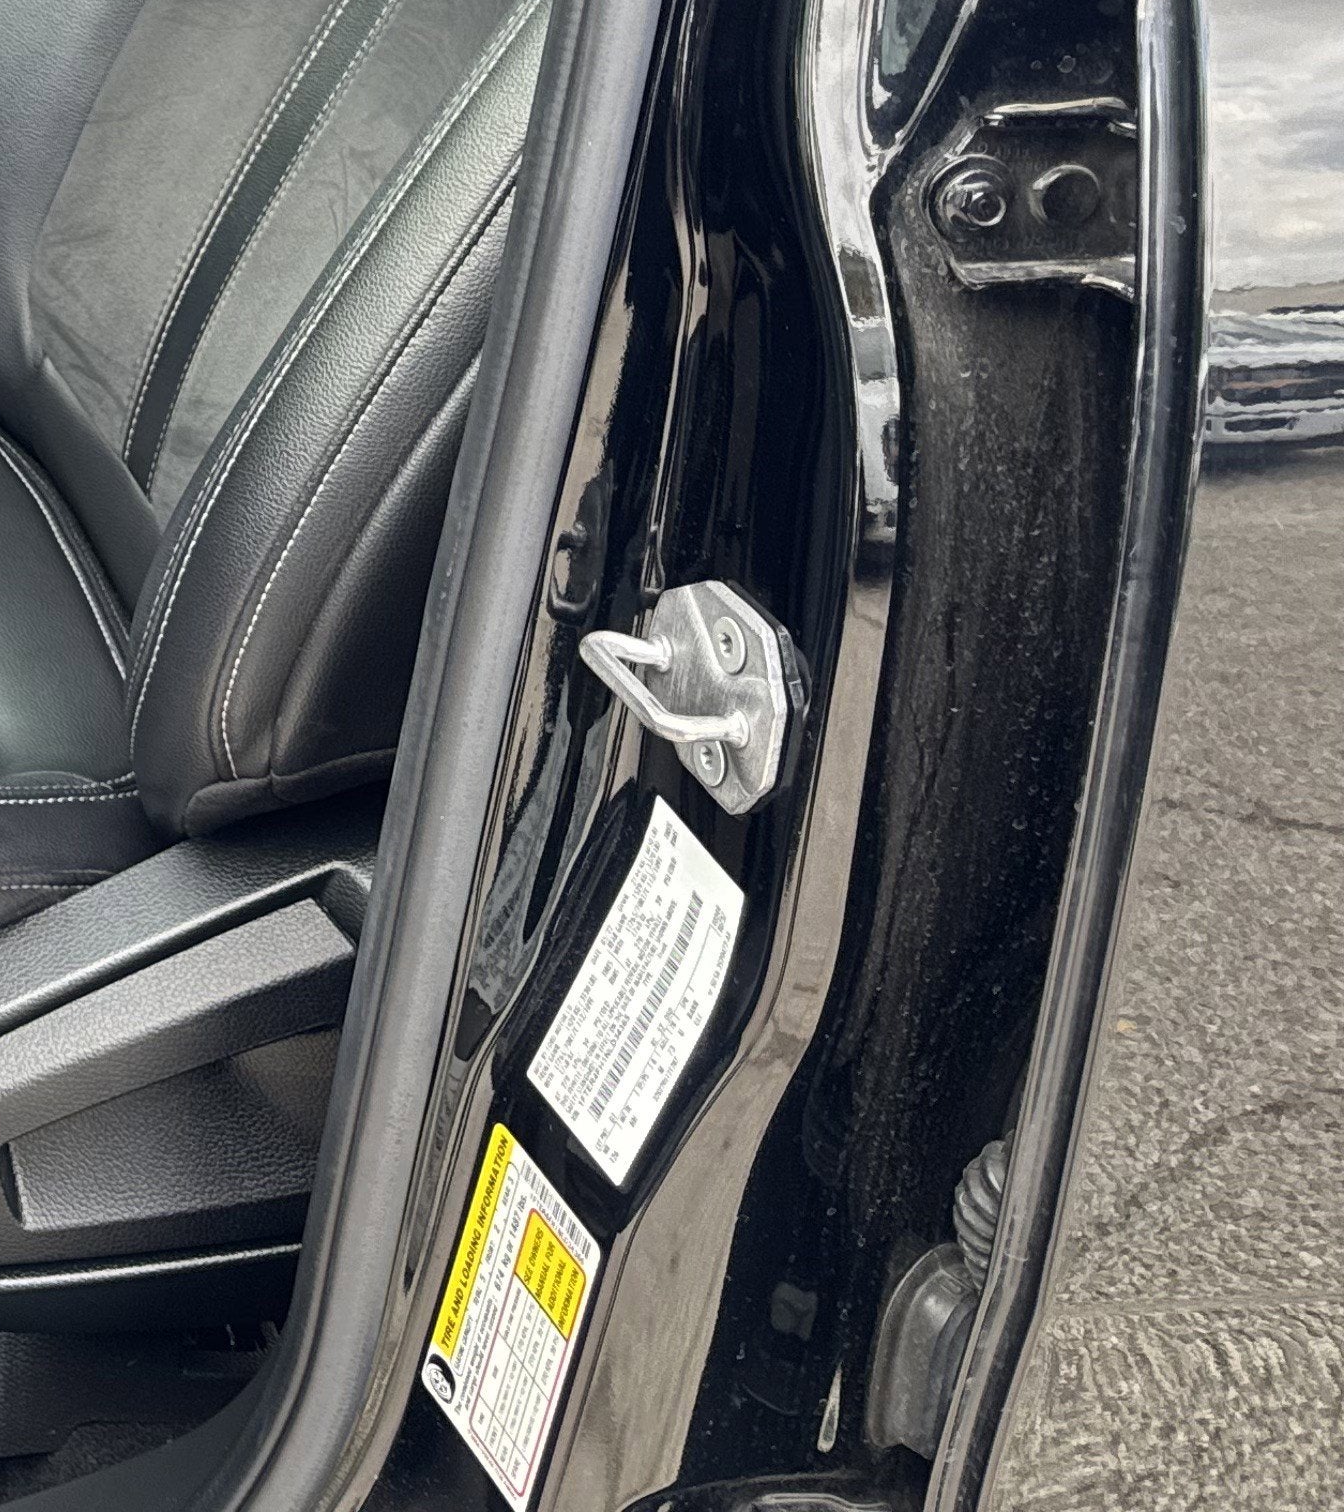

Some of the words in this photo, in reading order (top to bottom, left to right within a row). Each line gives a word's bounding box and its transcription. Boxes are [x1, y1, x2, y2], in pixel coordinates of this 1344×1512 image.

[440, 1314, 456, 1351] TIRE
[449, 1285, 464, 1318] AND
[458, 1225, 482, 1289] LOADING
[474, 1132, 510, 1230] INFORMATION
[500, 1250, 511, 1270] kg
[506, 1238, 514, 1254] or
[545, 1256, 567, 1313] ADDITIONAL
[556, 1266, 580, 1331] INFORMATION
